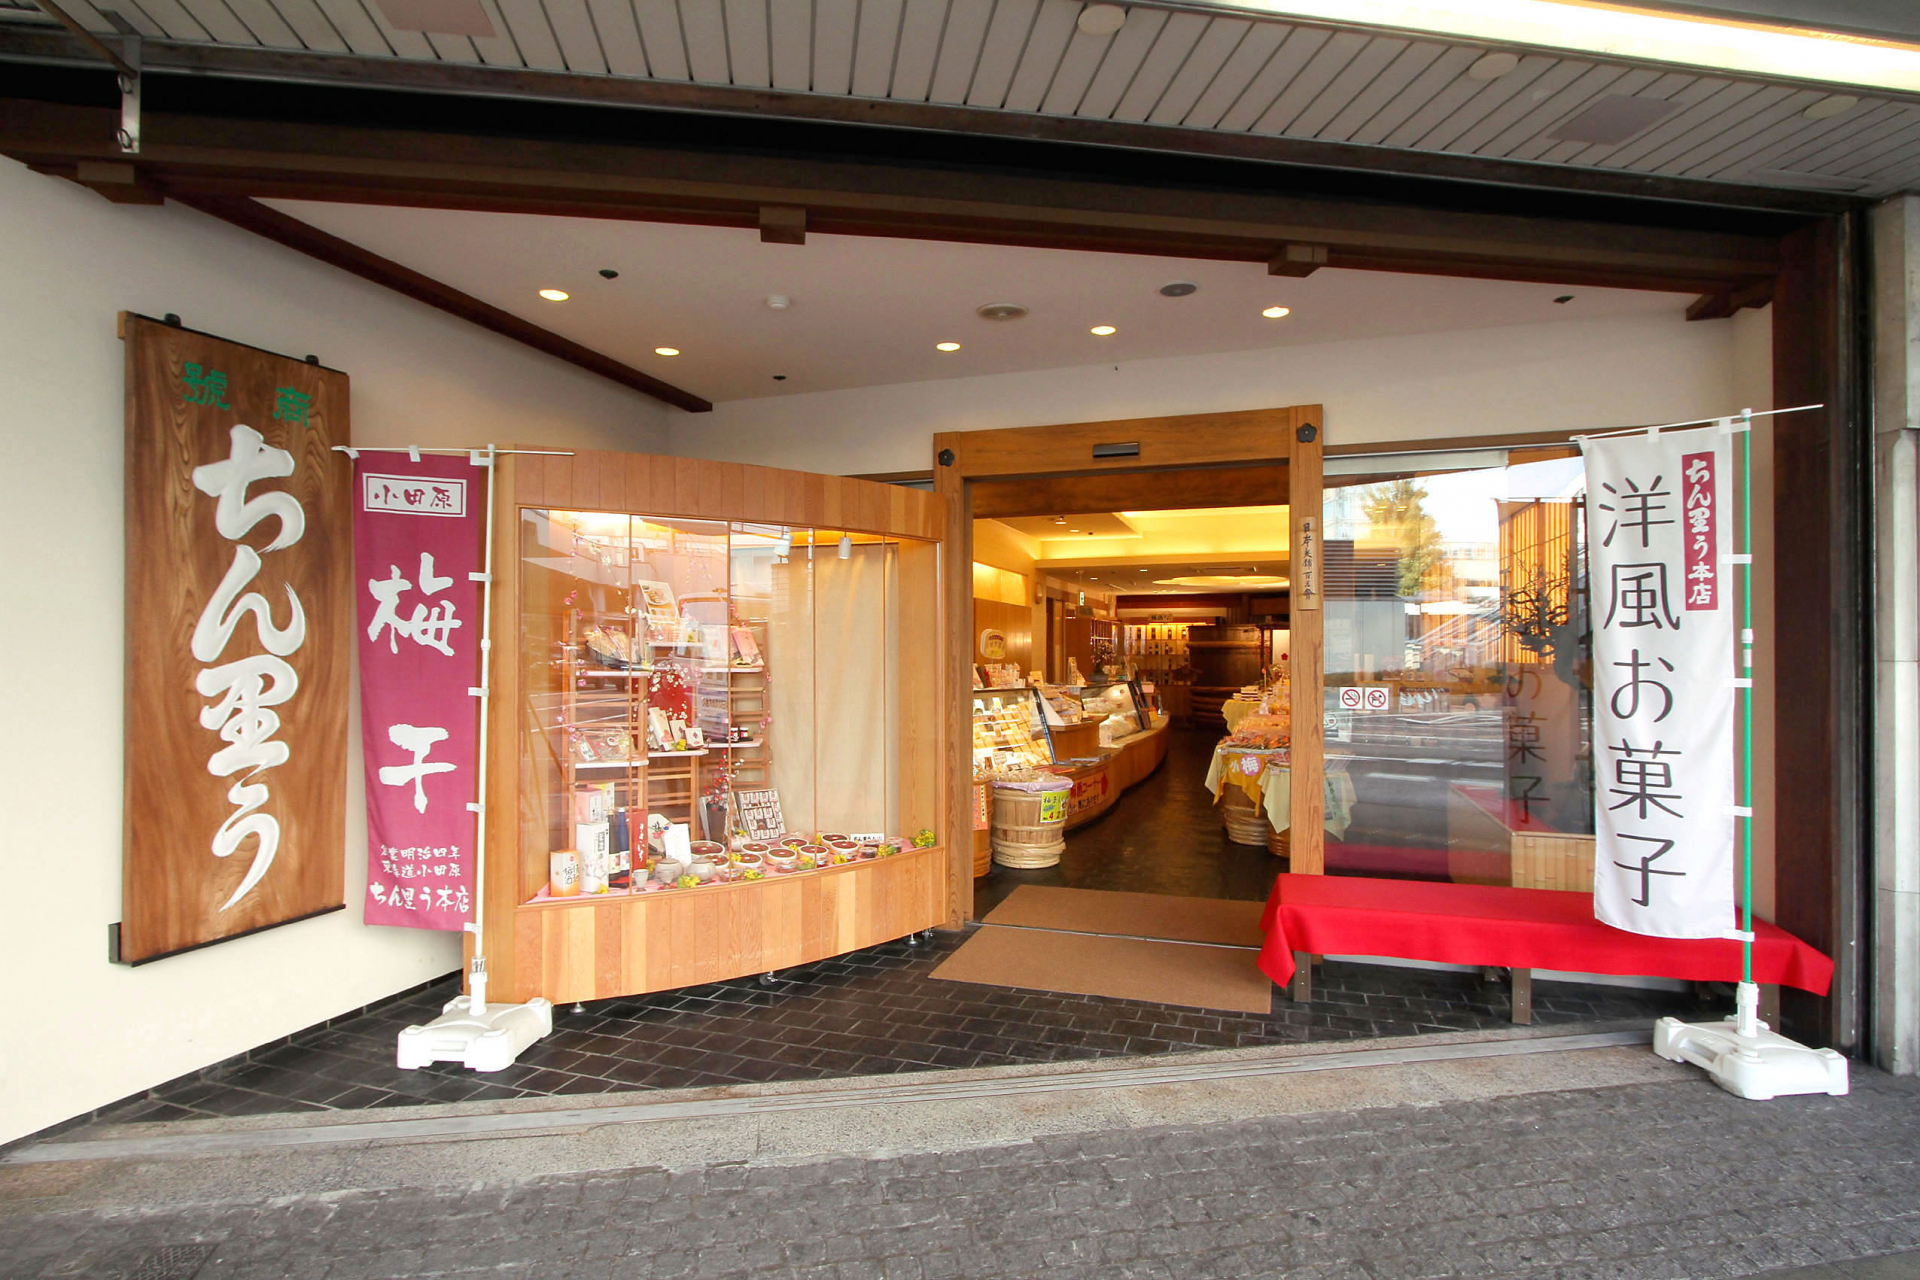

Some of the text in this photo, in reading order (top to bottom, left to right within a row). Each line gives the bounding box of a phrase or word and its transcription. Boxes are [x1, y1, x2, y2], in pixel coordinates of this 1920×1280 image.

[374, 484, 452, 509] 小田原
[1685, 459, 1715, 605] ちん里う本店
[367, 552, 462, 814] 梅干
[1599, 475, 1686, 907] 洋風お菓子
[370, 881, 470, 913] ちん里う本店
